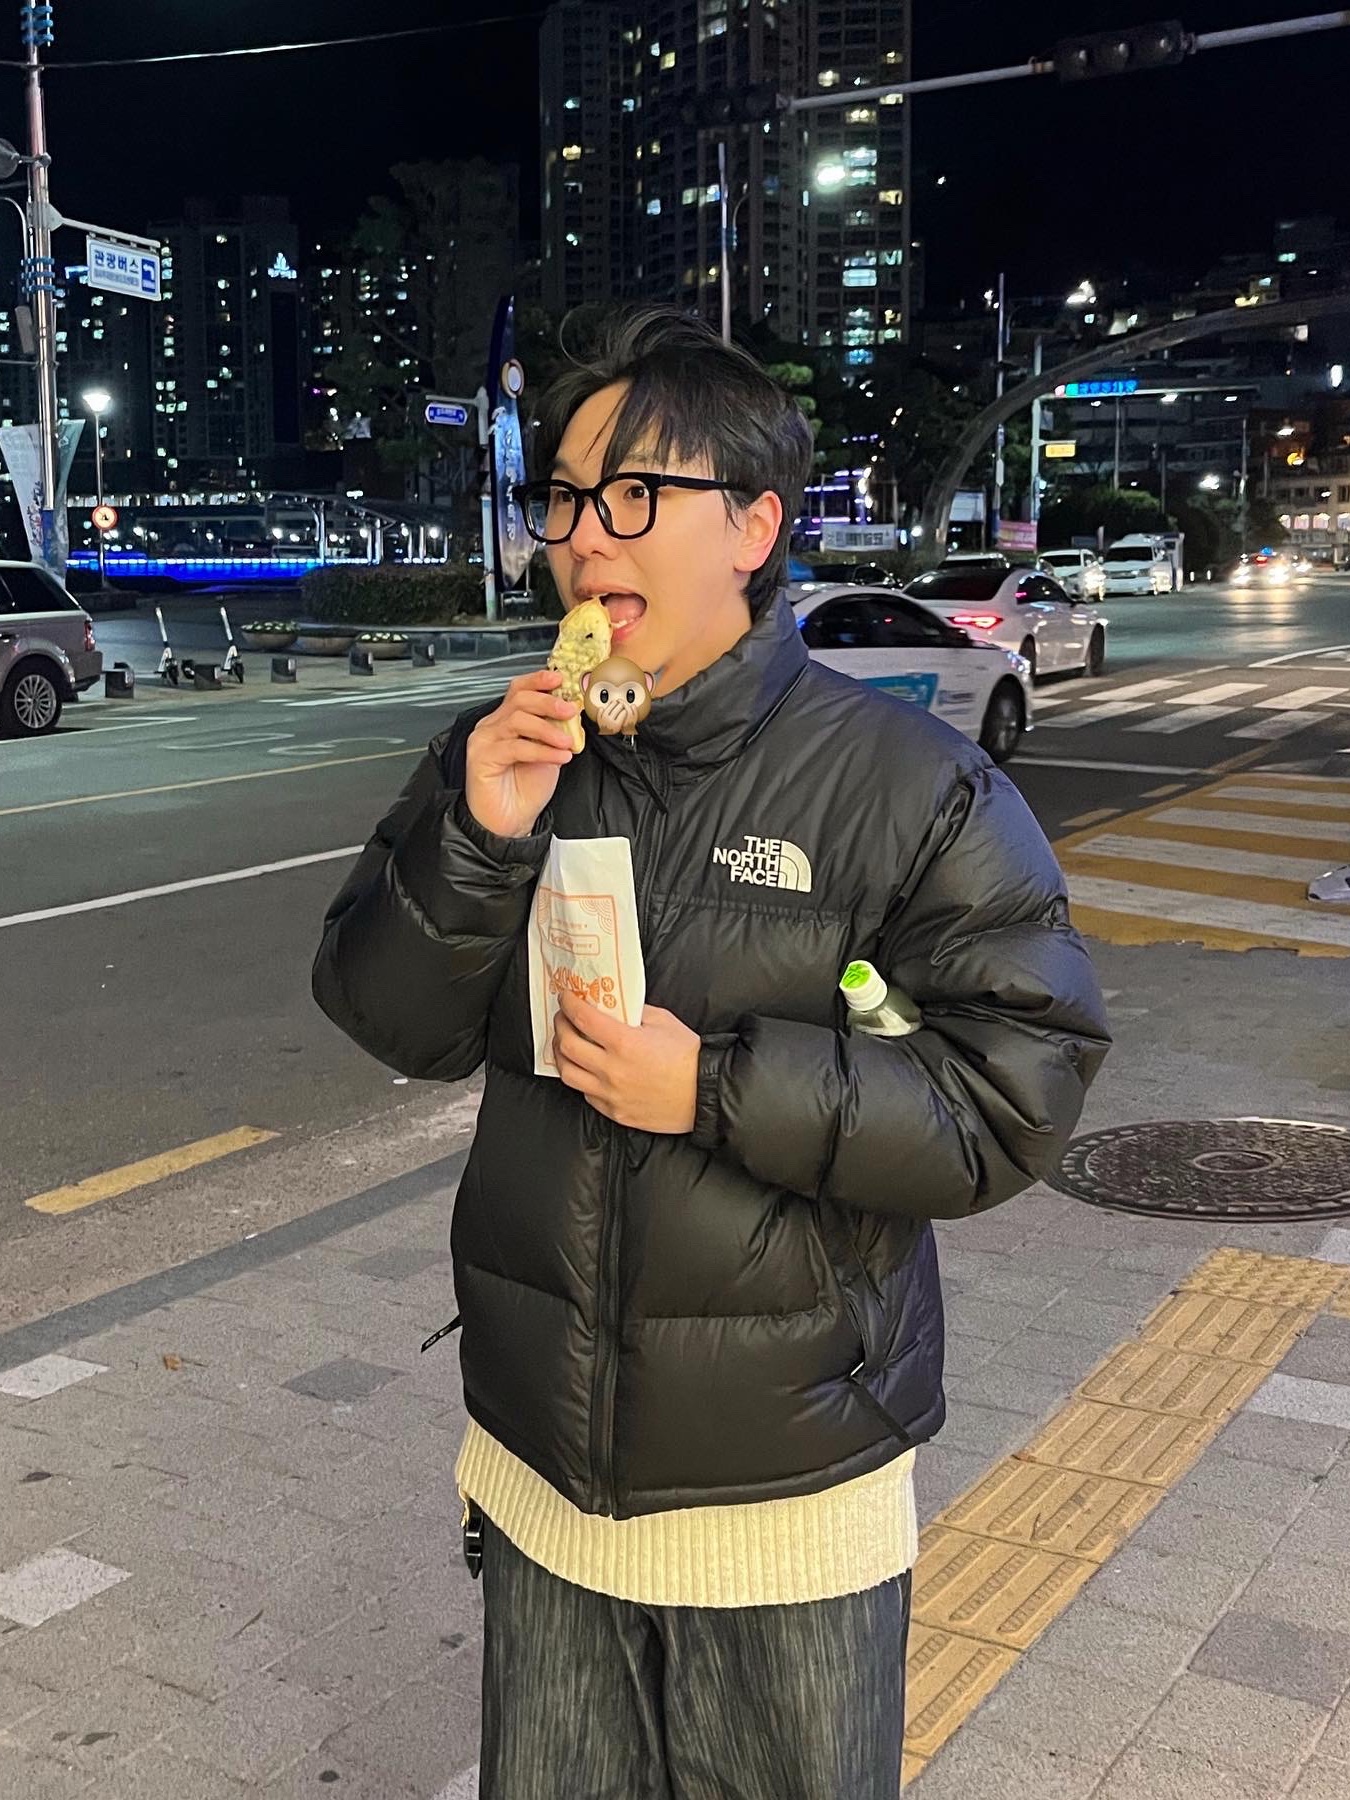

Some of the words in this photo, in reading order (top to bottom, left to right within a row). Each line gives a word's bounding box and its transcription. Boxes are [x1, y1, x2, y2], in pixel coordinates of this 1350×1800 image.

[94, 249, 139, 275] 관광버스
[743, 835, 781, 855] THE
[712, 847, 780, 872] NORTH
[730, 865, 778, 887] FACE
